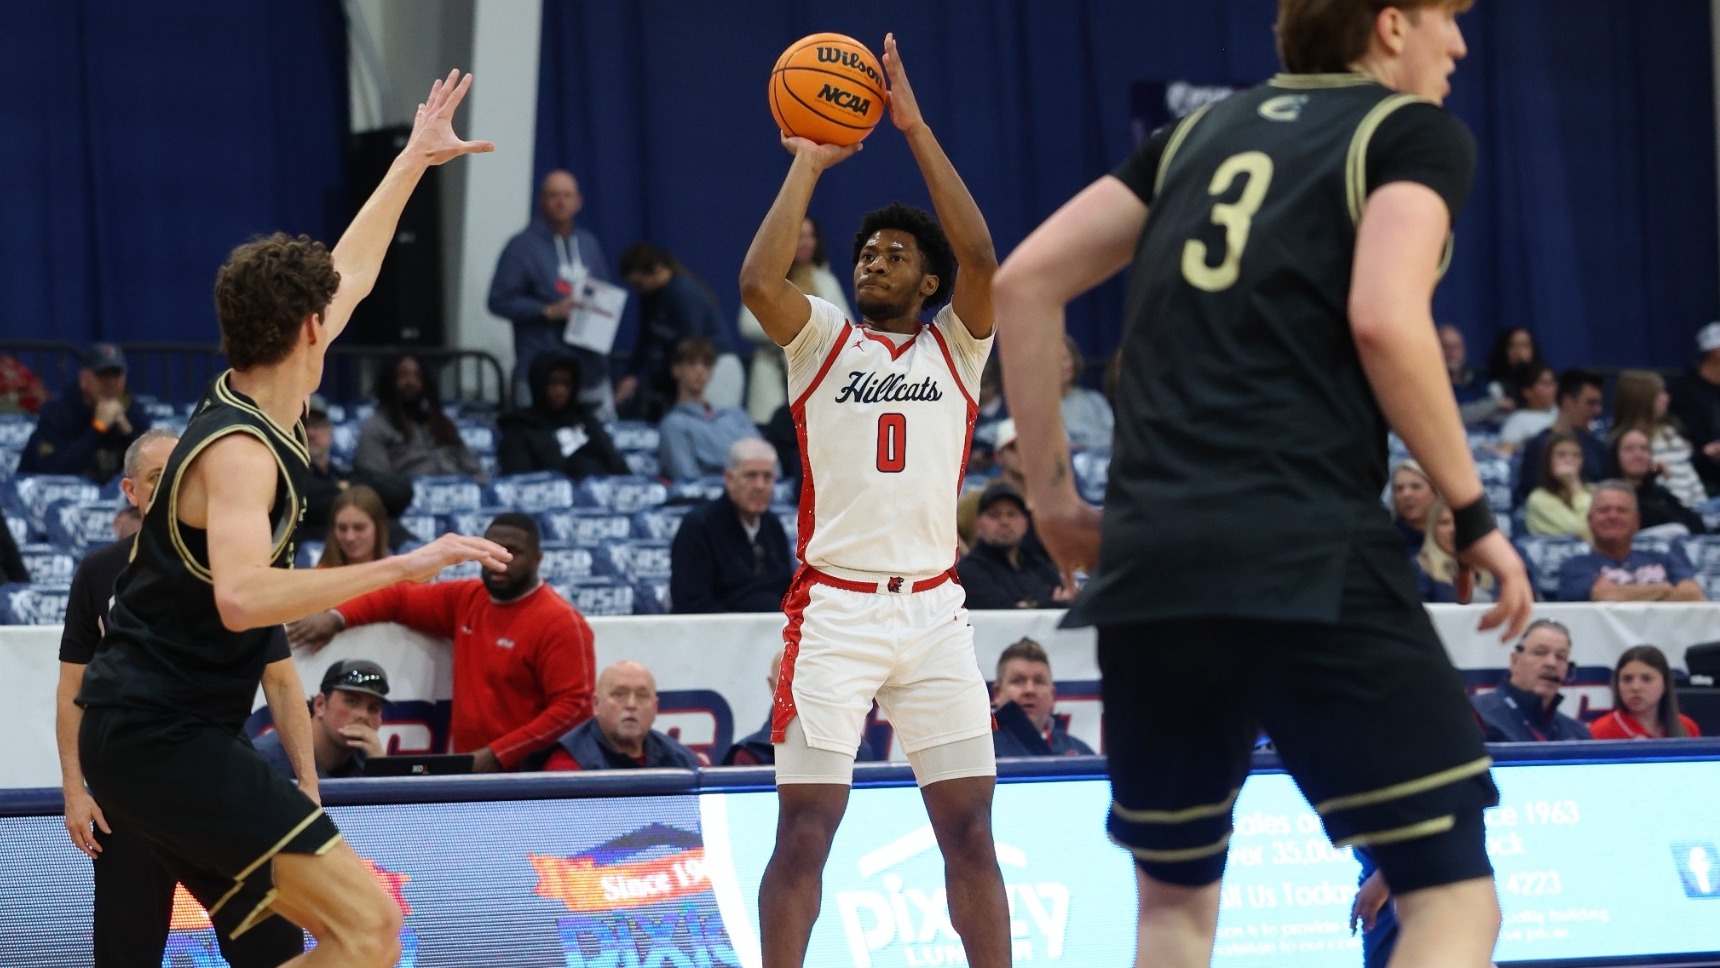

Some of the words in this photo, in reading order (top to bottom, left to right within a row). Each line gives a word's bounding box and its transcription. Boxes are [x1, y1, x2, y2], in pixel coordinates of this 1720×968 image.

[816, 46, 883, 90] Wilson
[816, 83, 871, 116] NCAA
[1181, 150, 1274, 292] 3
[834, 370, 943, 404] Hillcats
[876, 412, 907, 473] 0
[1236, 811, 1290, 836] ales
[1524, 799, 1580, 825] 1963
[601, 872, 672, 900] Since
